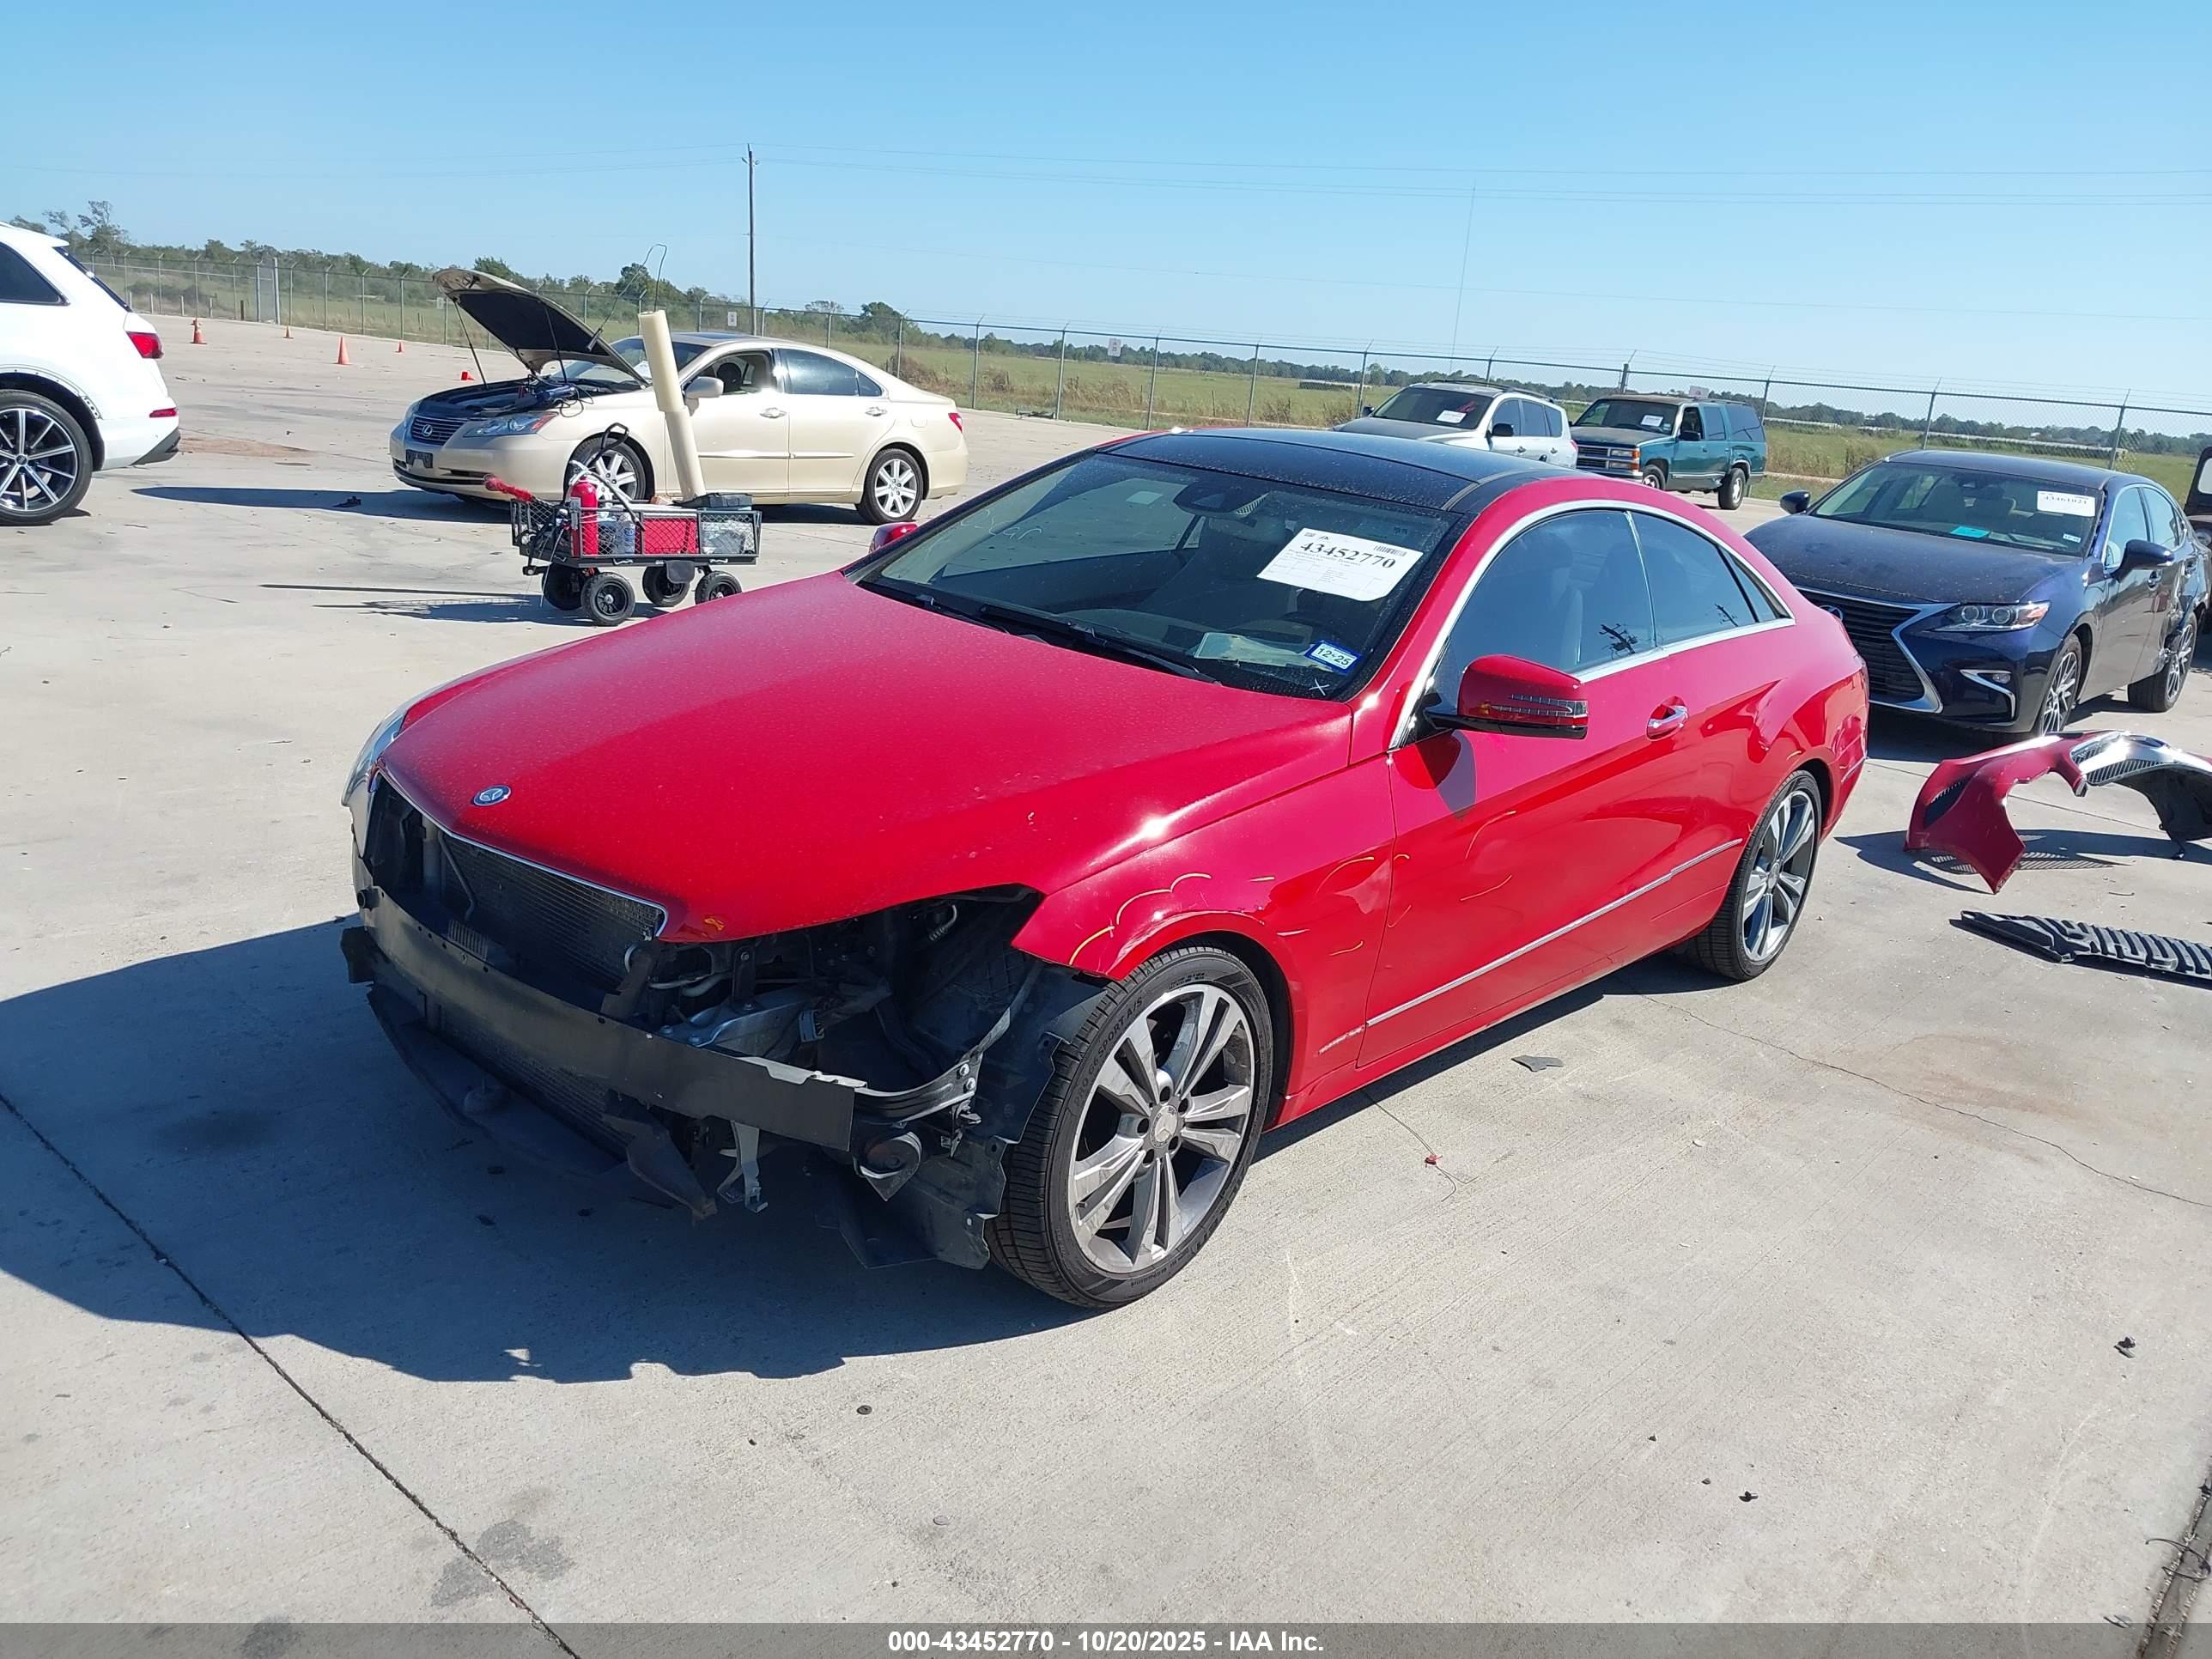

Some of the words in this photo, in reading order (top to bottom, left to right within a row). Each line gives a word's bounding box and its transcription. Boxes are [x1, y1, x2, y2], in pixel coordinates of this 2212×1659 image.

[1300, 542, 1396, 568] 43452770
[1097, 1017, 1126, 1056] SPORT
[1127, 996, 1144, 1019] A/S
